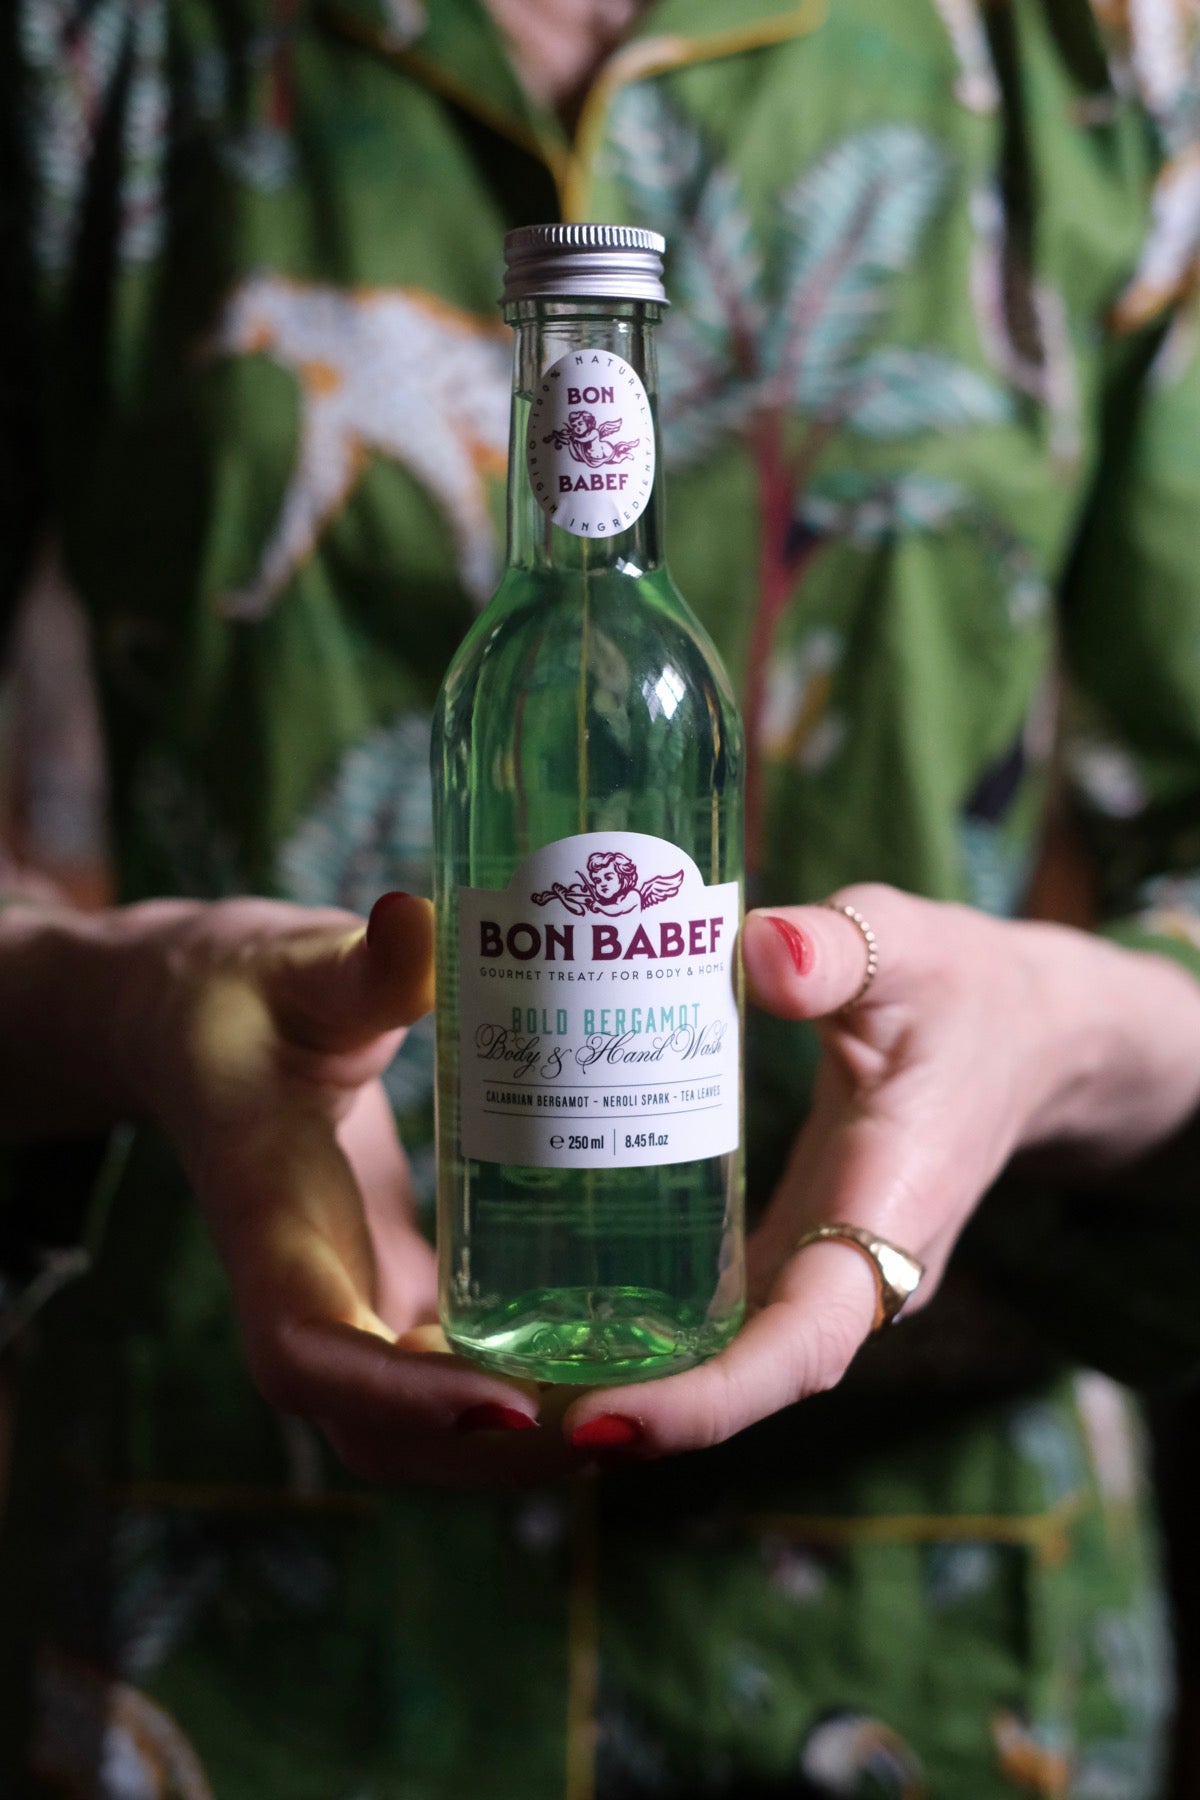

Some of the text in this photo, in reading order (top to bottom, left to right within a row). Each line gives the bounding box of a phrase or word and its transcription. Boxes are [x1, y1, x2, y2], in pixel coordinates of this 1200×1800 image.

[567, 386, 615, 405] BON
[575, 355, 646, 414] NATURAL
[529, 440, 558, 514] ORIGIN
[558, 473, 629, 493] BABEF
[479, 916, 724, 961] BON BABEF
[479, 962, 724, 982] GOURMET TREATS FOR BODY & HOME
[512, 1003, 701, 1036] BOLD BERGAMOT
[476, 1019, 728, 1079] Body & Hand Wash
[486, 1089, 533, 1106] CALABRIAN
[537, 1095, 589, 1108] BERGAMOT
[603, 1095, 638, 1108] NEROLI
[641, 1092, 670, 1106] SPARK
[681, 1089, 695, 1102] TEA
[697, 1084, 721, 1100] LEAVES
[568, 1135, 589, 1150] 250
[590, 1135, 604, 1149] ml
[625, 1133, 647, 1149] 8.45
